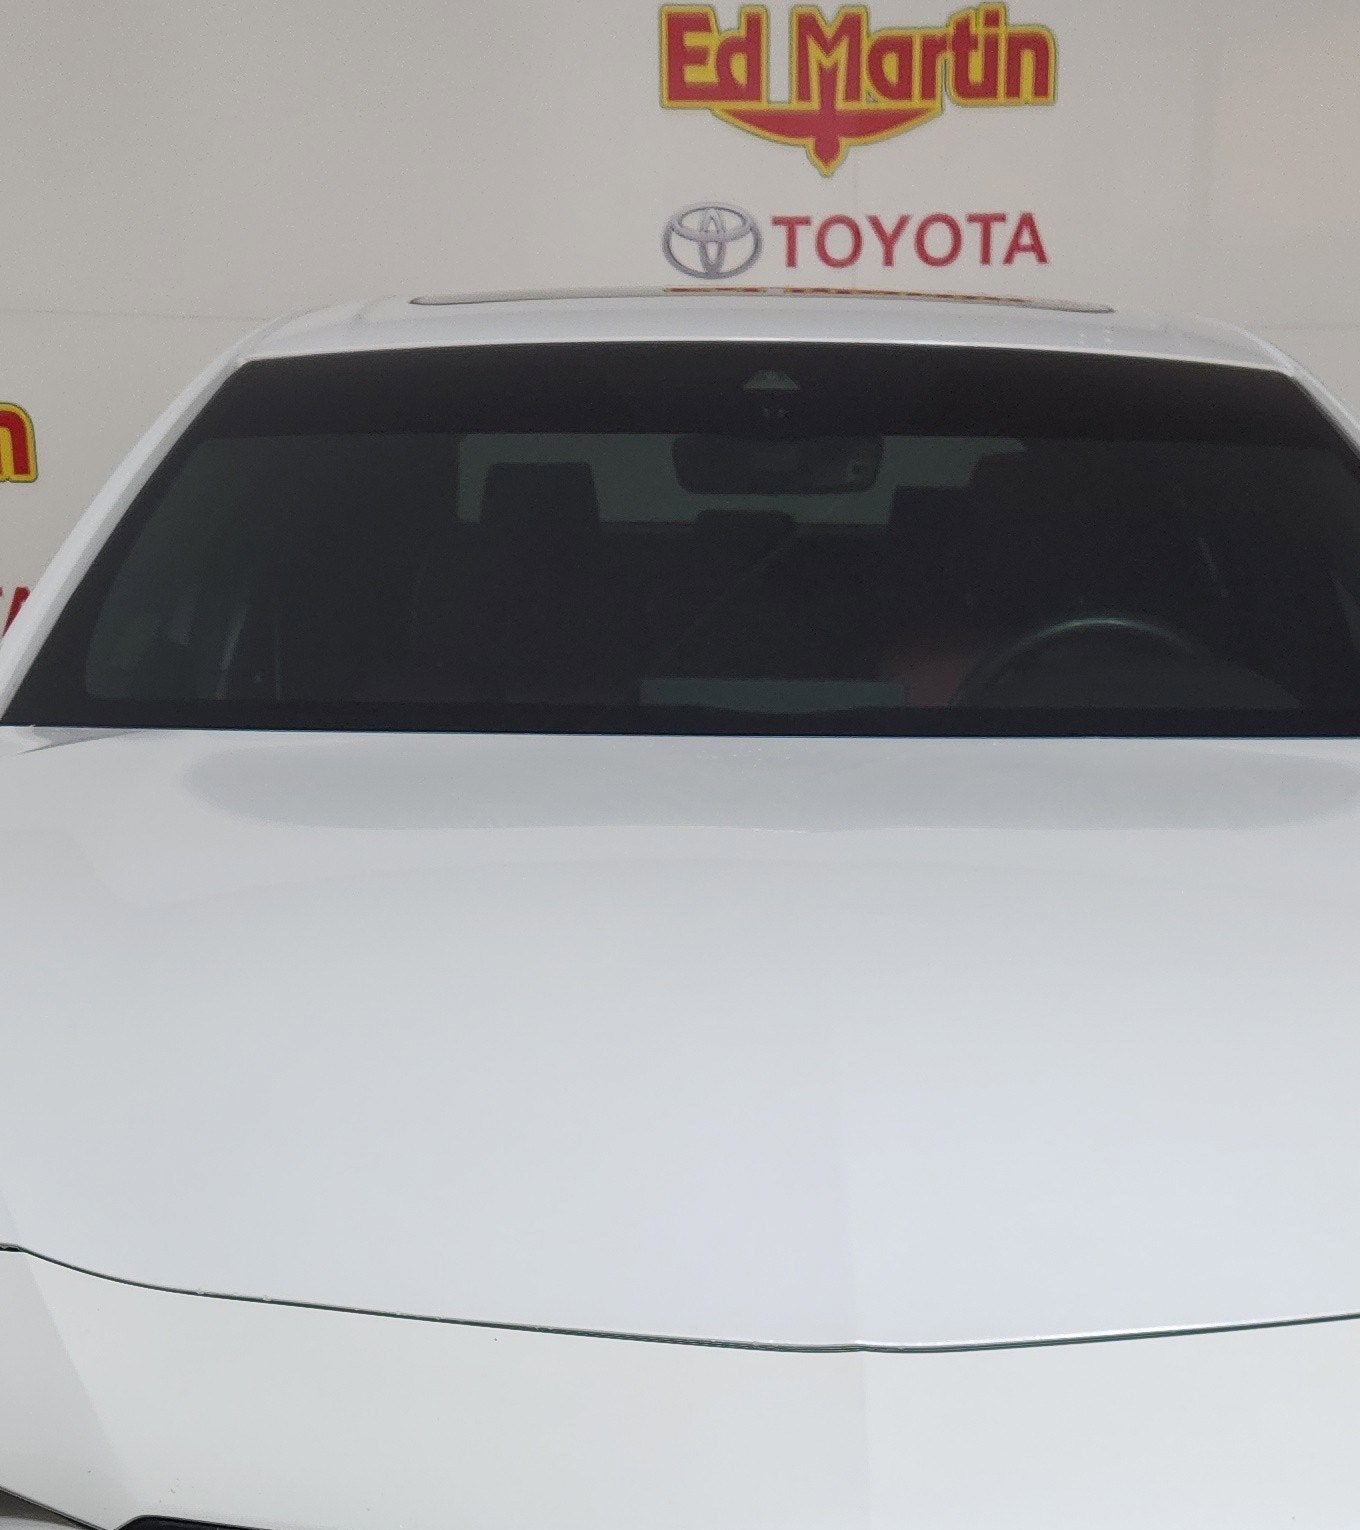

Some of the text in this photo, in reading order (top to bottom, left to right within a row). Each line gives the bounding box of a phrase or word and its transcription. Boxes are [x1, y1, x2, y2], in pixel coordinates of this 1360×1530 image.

[661, 3, 1057, 107] Ed Martin
[772, 212, 1049, 268] TOYOTA
